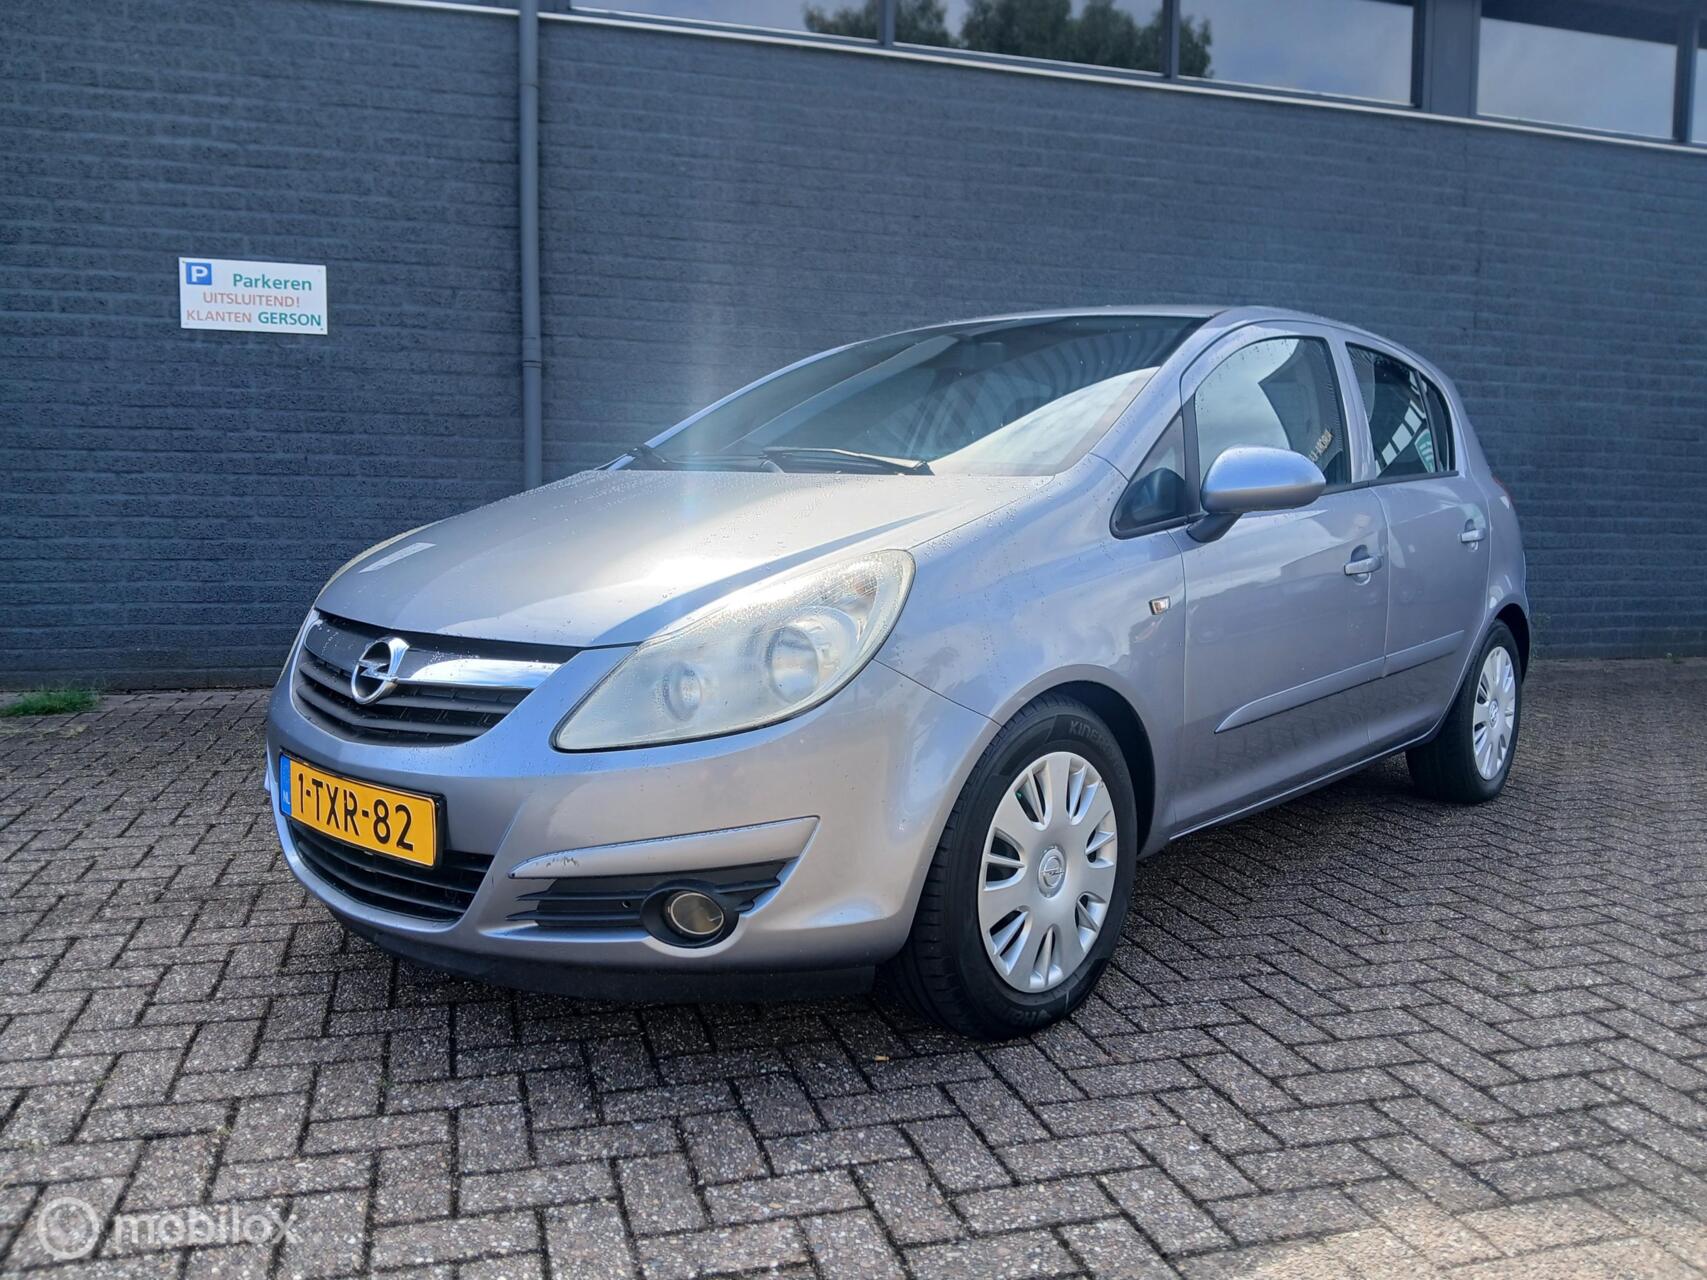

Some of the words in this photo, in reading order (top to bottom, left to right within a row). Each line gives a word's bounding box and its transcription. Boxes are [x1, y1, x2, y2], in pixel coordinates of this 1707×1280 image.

[190, 265, 208, 282] P
[233, 273, 312, 291] Parkeren
[203, 291, 300, 308] UITSLUITEND!
[186, 310, 251, 323] KLANTEN
[258, 311, 321, 326] GERSON
[298, 773, 413, 851] 1-TXR-82
